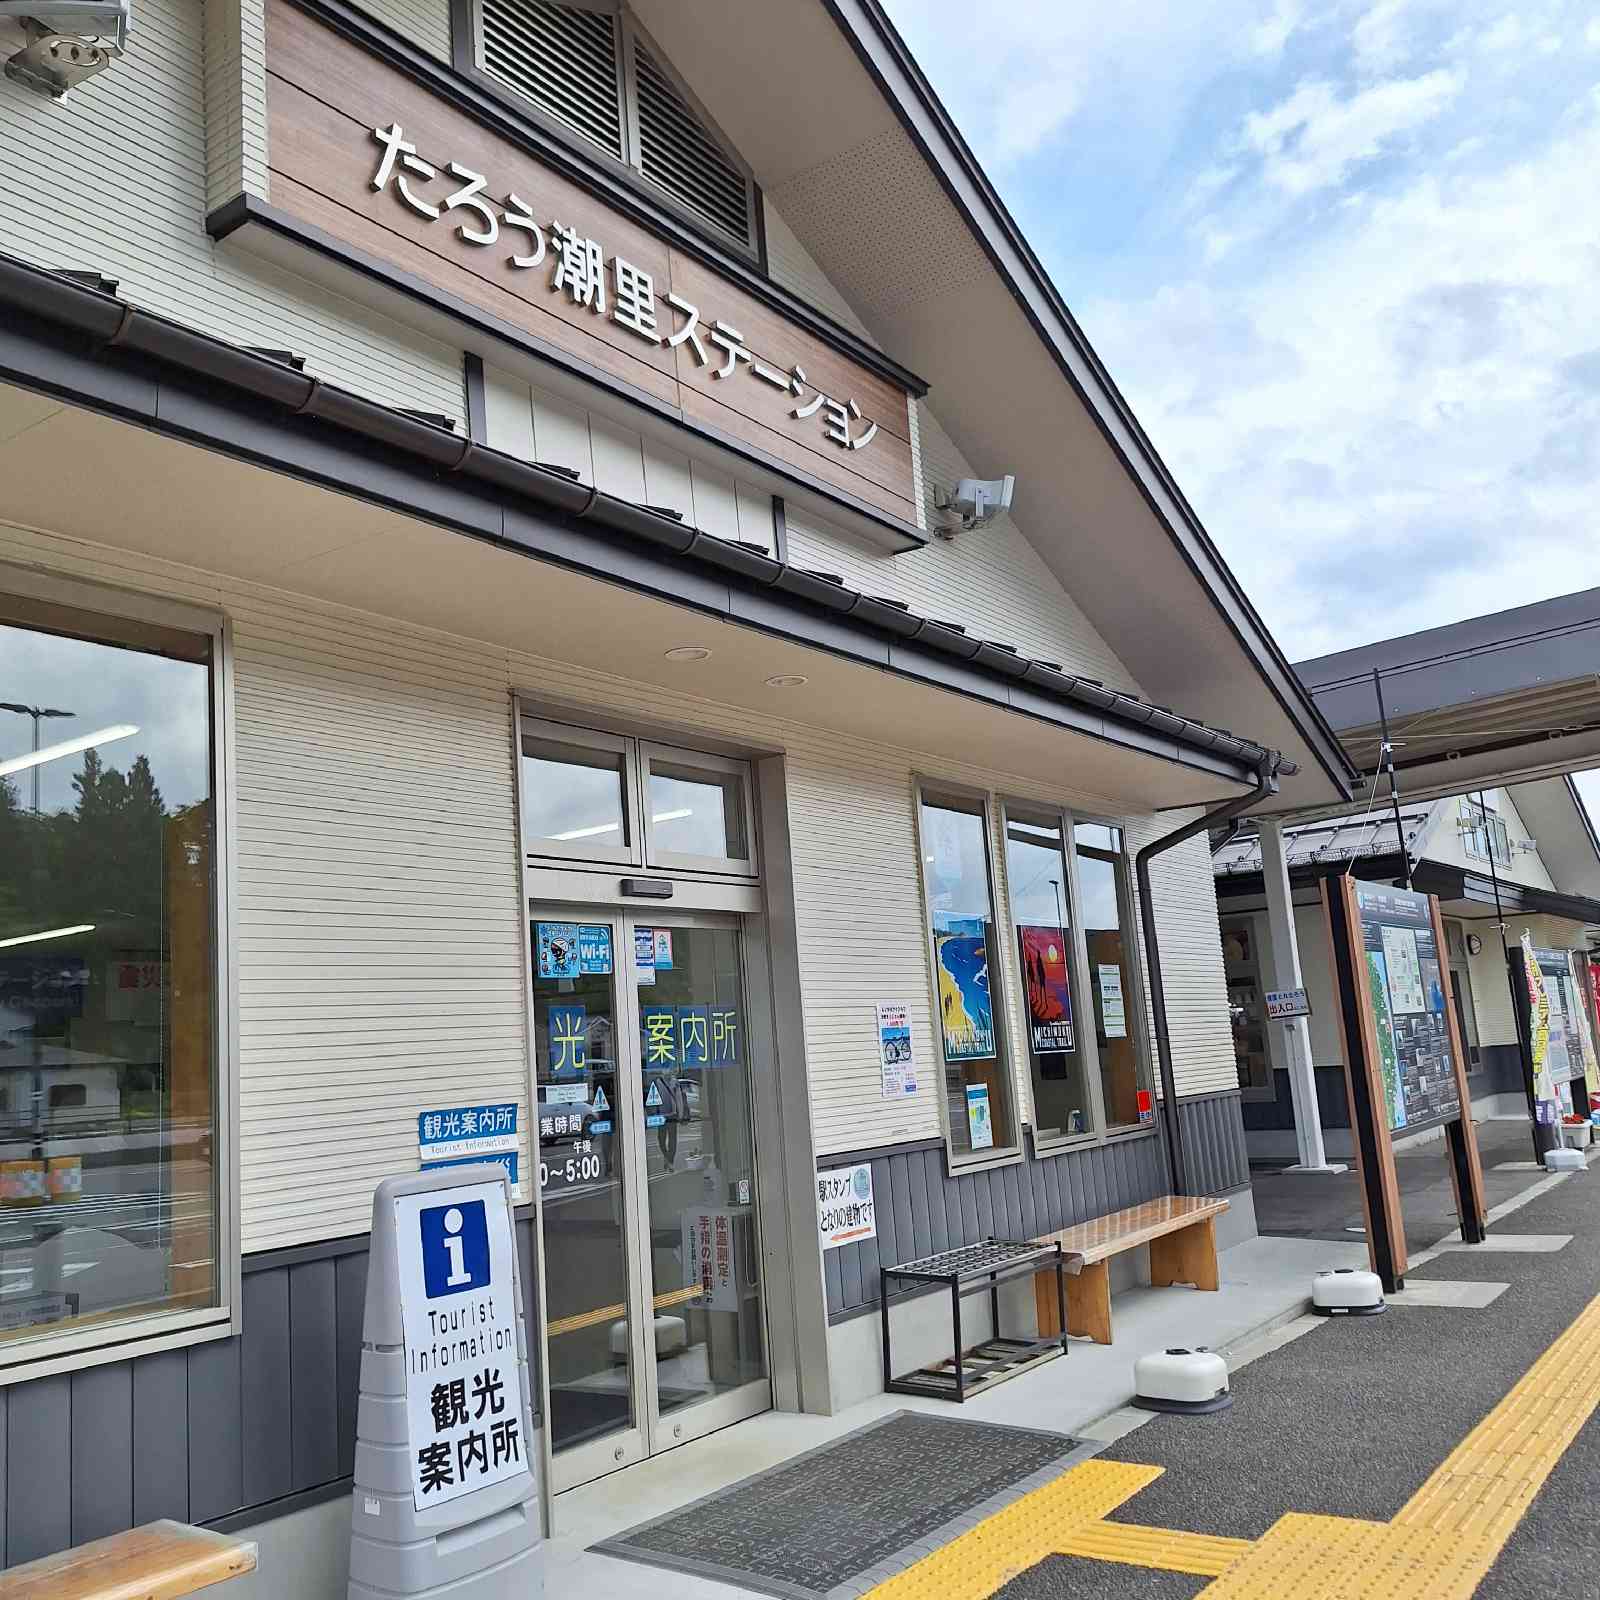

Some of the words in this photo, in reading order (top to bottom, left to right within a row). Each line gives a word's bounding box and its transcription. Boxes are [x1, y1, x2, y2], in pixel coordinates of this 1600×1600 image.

[369, 122, 878, 450] たろう潮里ステーション
[553, 1013, 585, 1070] 光
[647, 1011, 736, 1063] 案内所
[424, 1107, 513, 1139] 観光案内所
[540, 1114, 582, 1136] 業時間
[573, 1139, 592, 1153] 午後
[820, 1201, 873, 1232] となりの建物です
[428, 1297, 496, 1337] Tourist
[411, 1327, 512, 1375] Information
[430, 1367, 505, 1433] 観光
[418, 1418, 519, 1494] 案内所
